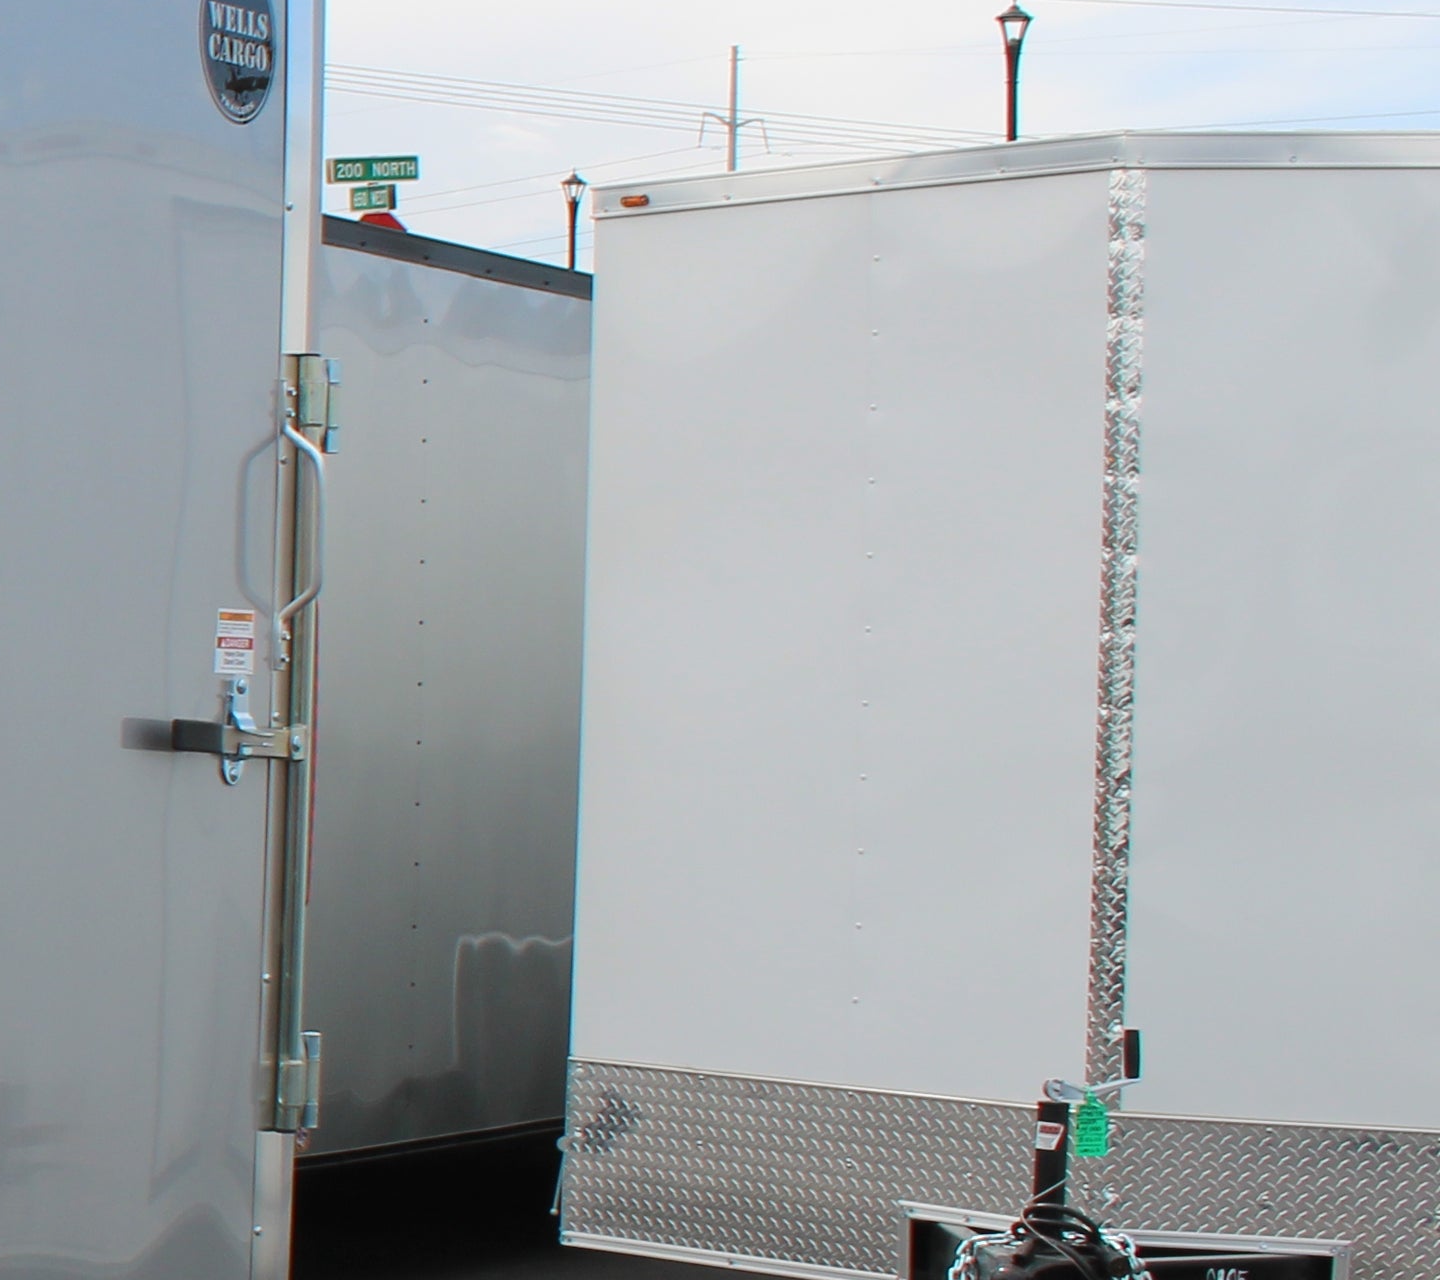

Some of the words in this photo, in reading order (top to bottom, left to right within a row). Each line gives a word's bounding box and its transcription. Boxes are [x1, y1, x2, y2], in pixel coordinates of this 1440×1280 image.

[208, 0, 269, 40] WELLS
[208, 33, 268, 72] CARGO
[336, 162, 363, 179] 200
[372, 160, 416, 177] NORTH
